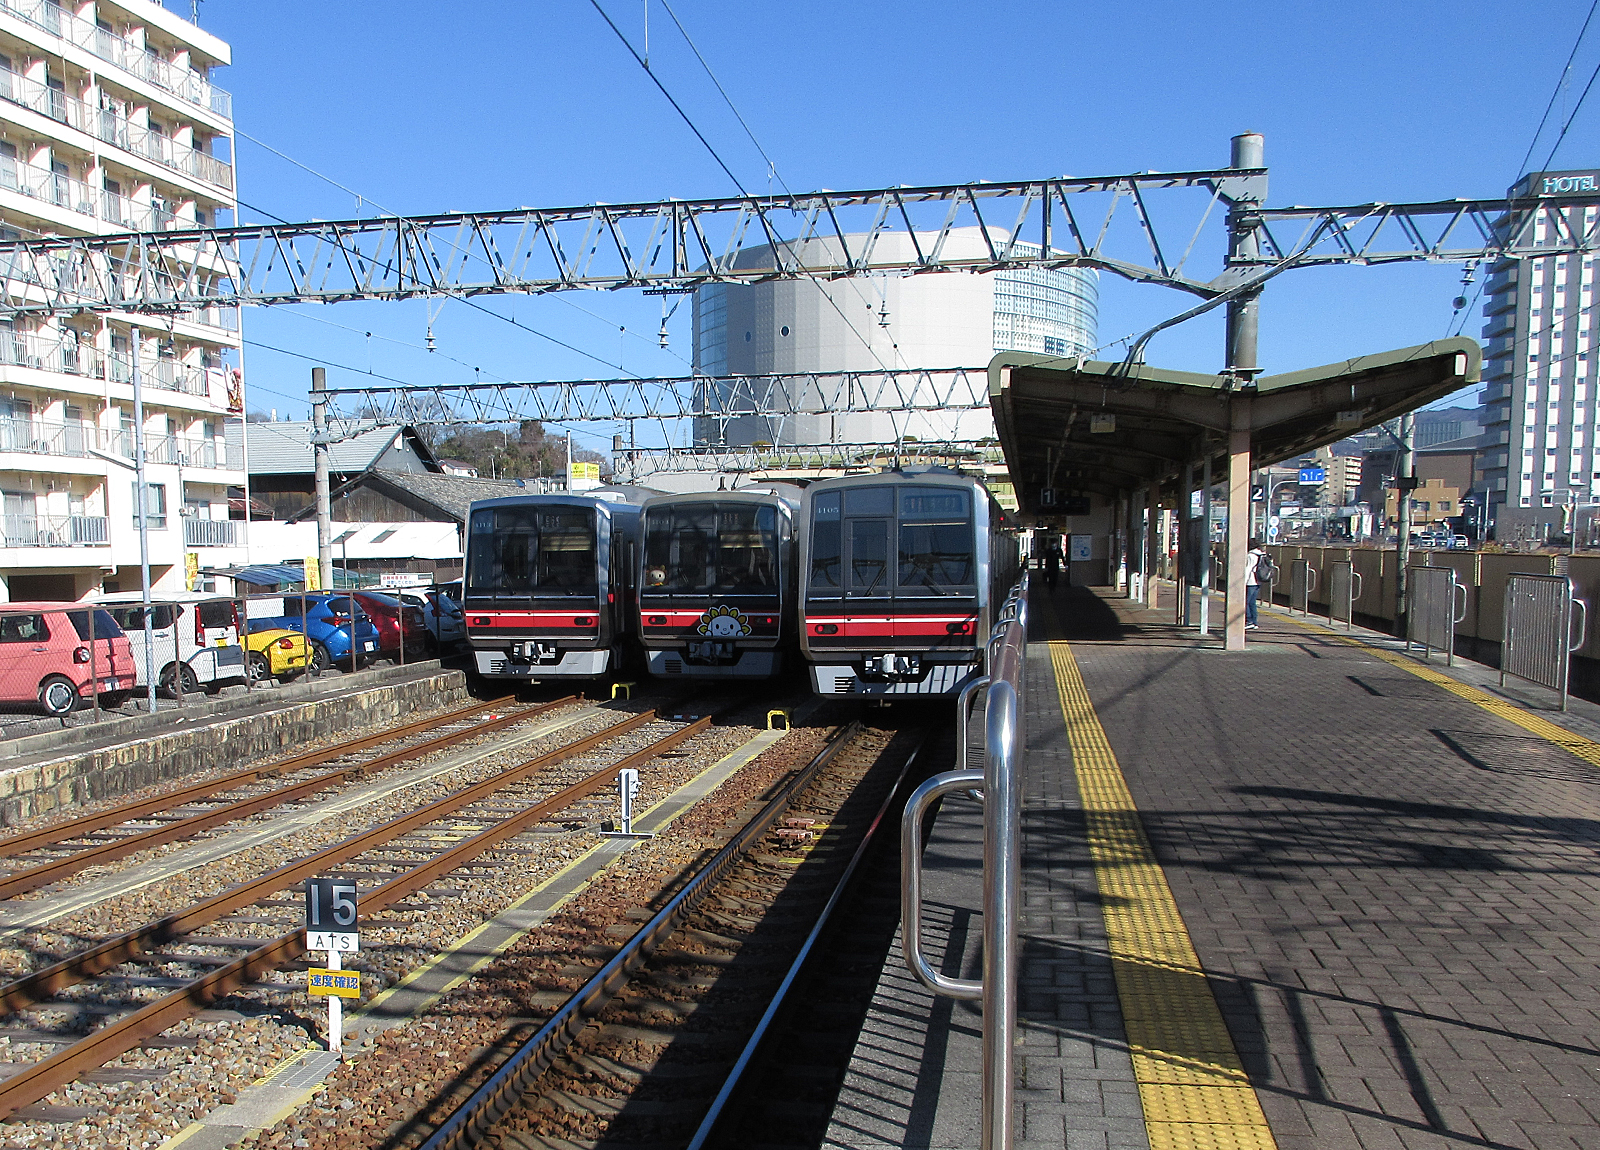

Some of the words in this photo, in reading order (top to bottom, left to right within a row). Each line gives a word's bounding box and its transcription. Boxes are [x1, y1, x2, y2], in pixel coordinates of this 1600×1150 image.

[1543, 175, 1599, 193] HOTEL
[1044, 490, 1051, 503] 1
[1252, 488, 1262, 499] 2
[311, 884, 356, 926] 15
[315, 933, 350, 950] ATS
[311, 974, 358, 989] 速度確認
